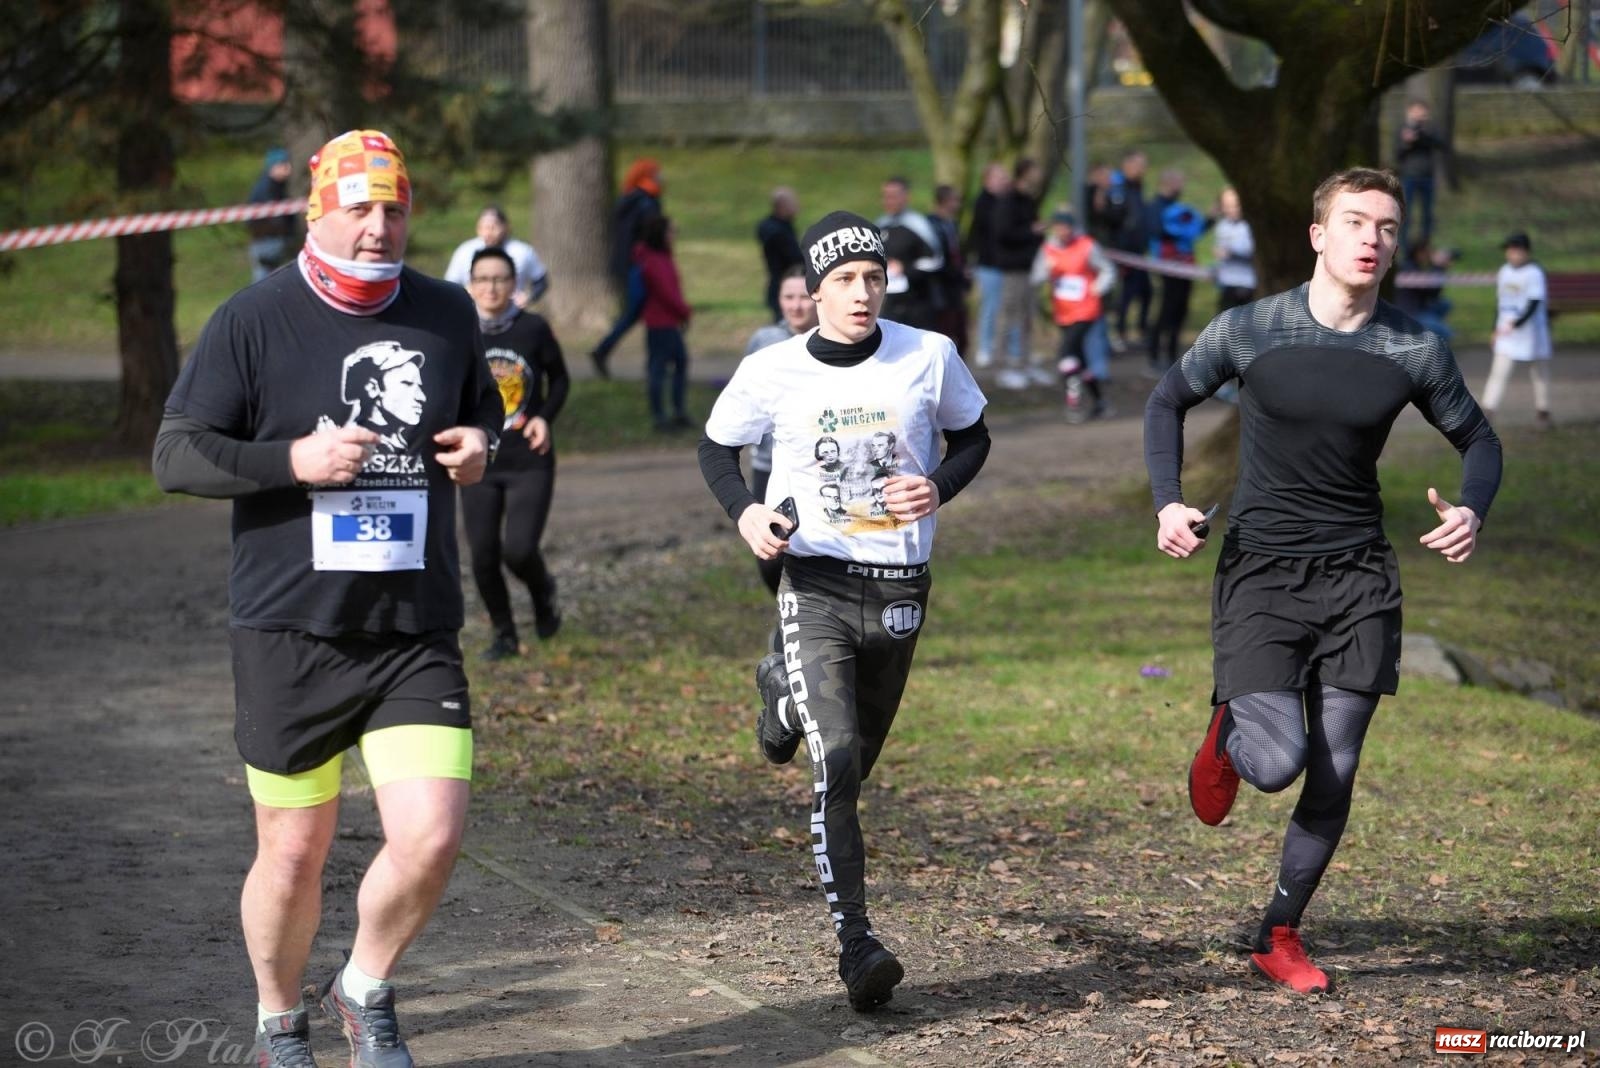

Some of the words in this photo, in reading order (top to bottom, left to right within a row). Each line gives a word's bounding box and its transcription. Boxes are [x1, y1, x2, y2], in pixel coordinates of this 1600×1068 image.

[813, 244, 845, 275] WEST
[841, 411, 886, 426] WILCZYM
[356, 515, 392, 541] 38
